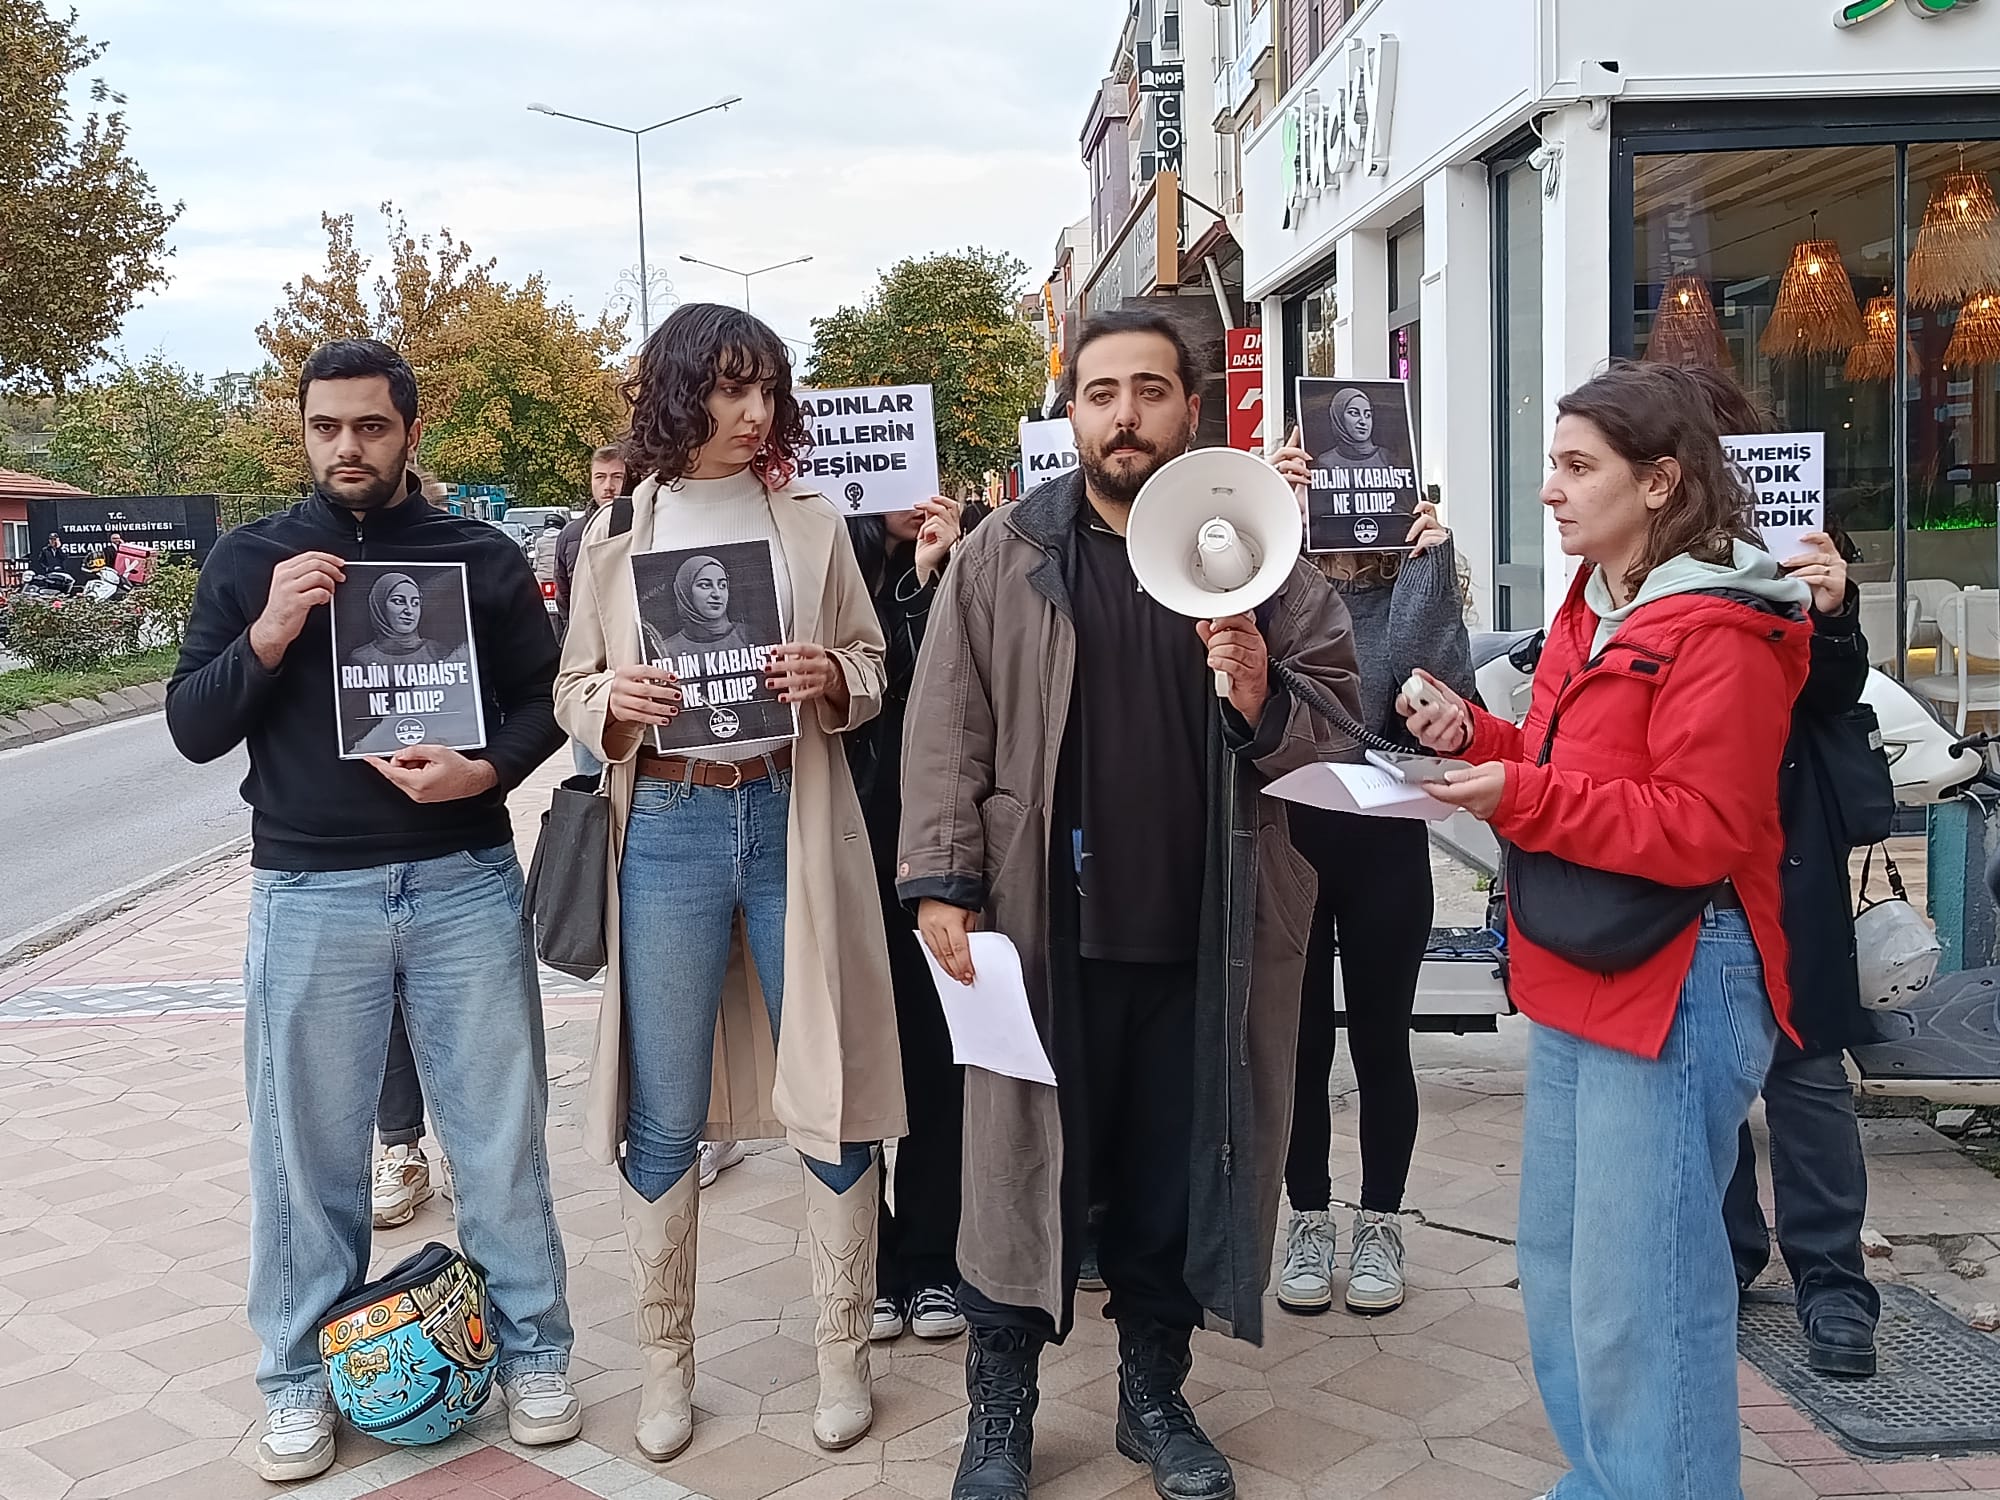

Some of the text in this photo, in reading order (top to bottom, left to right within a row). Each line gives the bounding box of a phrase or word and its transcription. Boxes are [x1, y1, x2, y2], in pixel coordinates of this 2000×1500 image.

[799, 394, 914, 418] ADINLAR
[799, 420, 914, 447] AİLLERİN
[1030, 452, 1077, 471] KAD
[1724, 443, 1811, 461] ÜLMEMİŞ
[797, 451, 907, 478] PEŞİNDE
[1738, 464, 1801, 483] YDIK
[1311, 466, 1350, 490] ROJİN
[1333, 492, 1396, 515] NE OLDU?
[1752, 505, 1815, 527] RDİK
[63, 524, 102, 533] TRAKYA
[341, 660, 469, 689] ROJİN KABAİŞ'E
[369, 690, 445, 716] NE OLDU?
[680, 676, 758, 708] NE OLDU?
